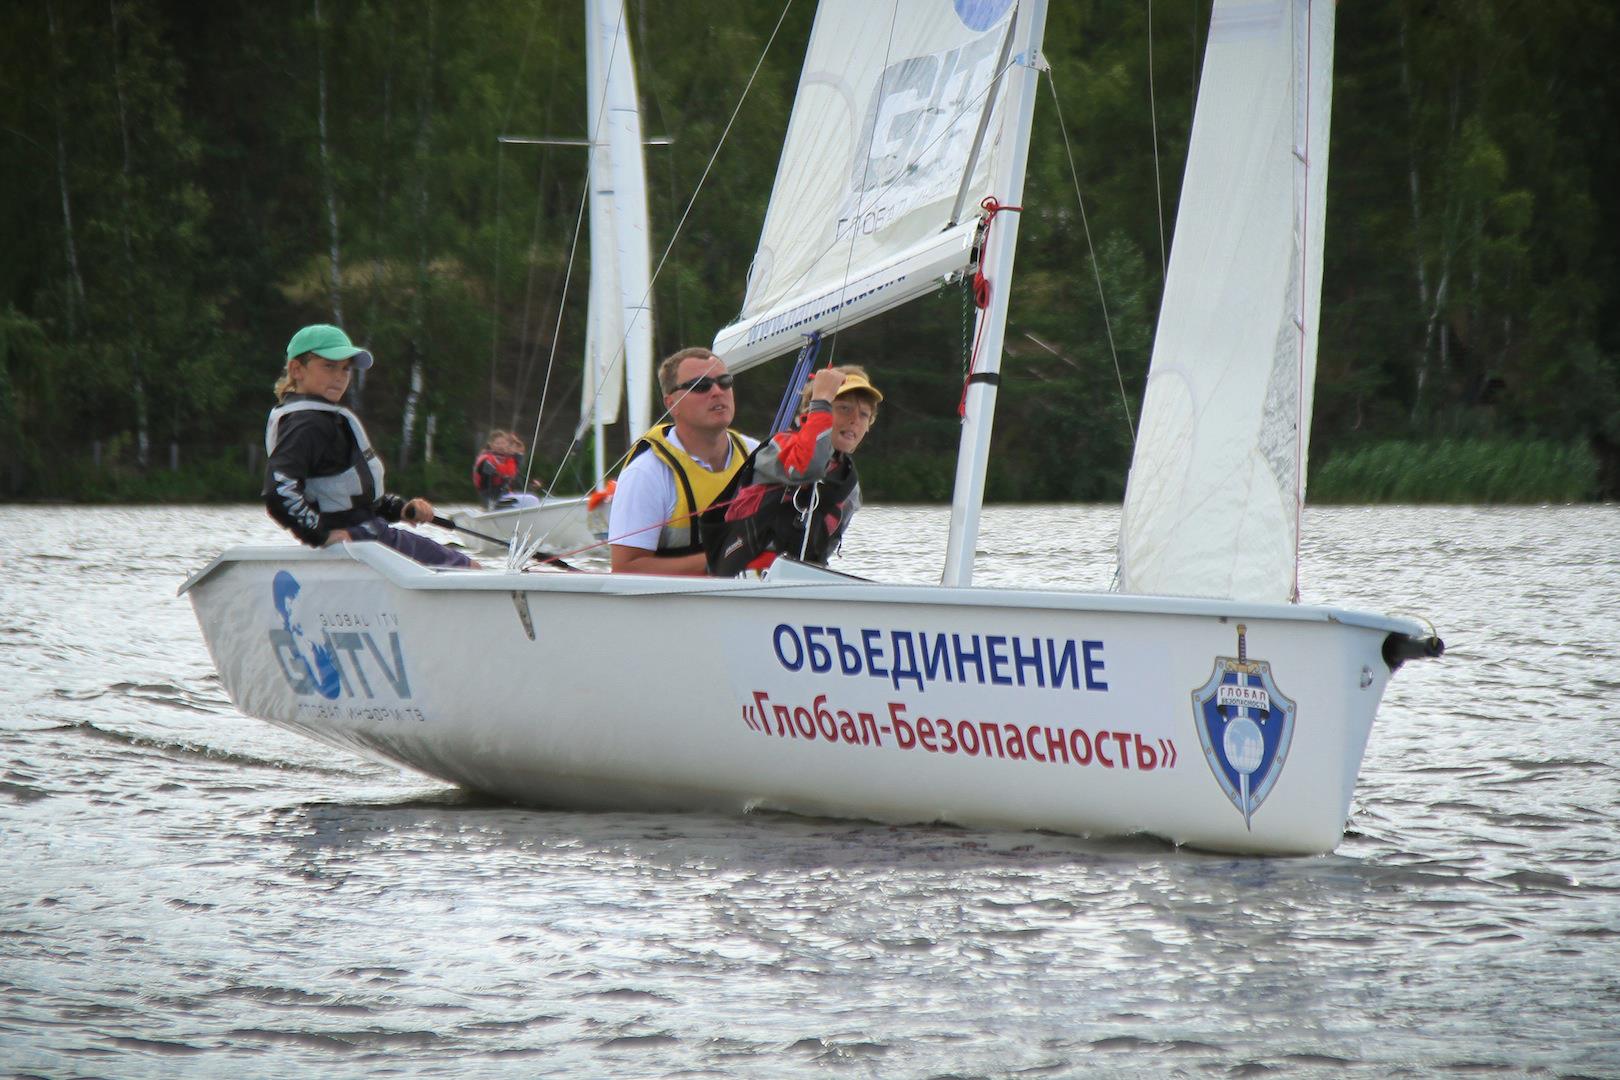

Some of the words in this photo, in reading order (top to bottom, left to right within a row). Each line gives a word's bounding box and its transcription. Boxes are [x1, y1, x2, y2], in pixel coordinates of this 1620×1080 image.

[772, 623, 1109, 692] ОБЪЕДИНЕНИЕ
[1220, 687, 1267, 701] ГЛОБАЛ
[742, 690, 1178, 771] «Глобал-Безопасность»
